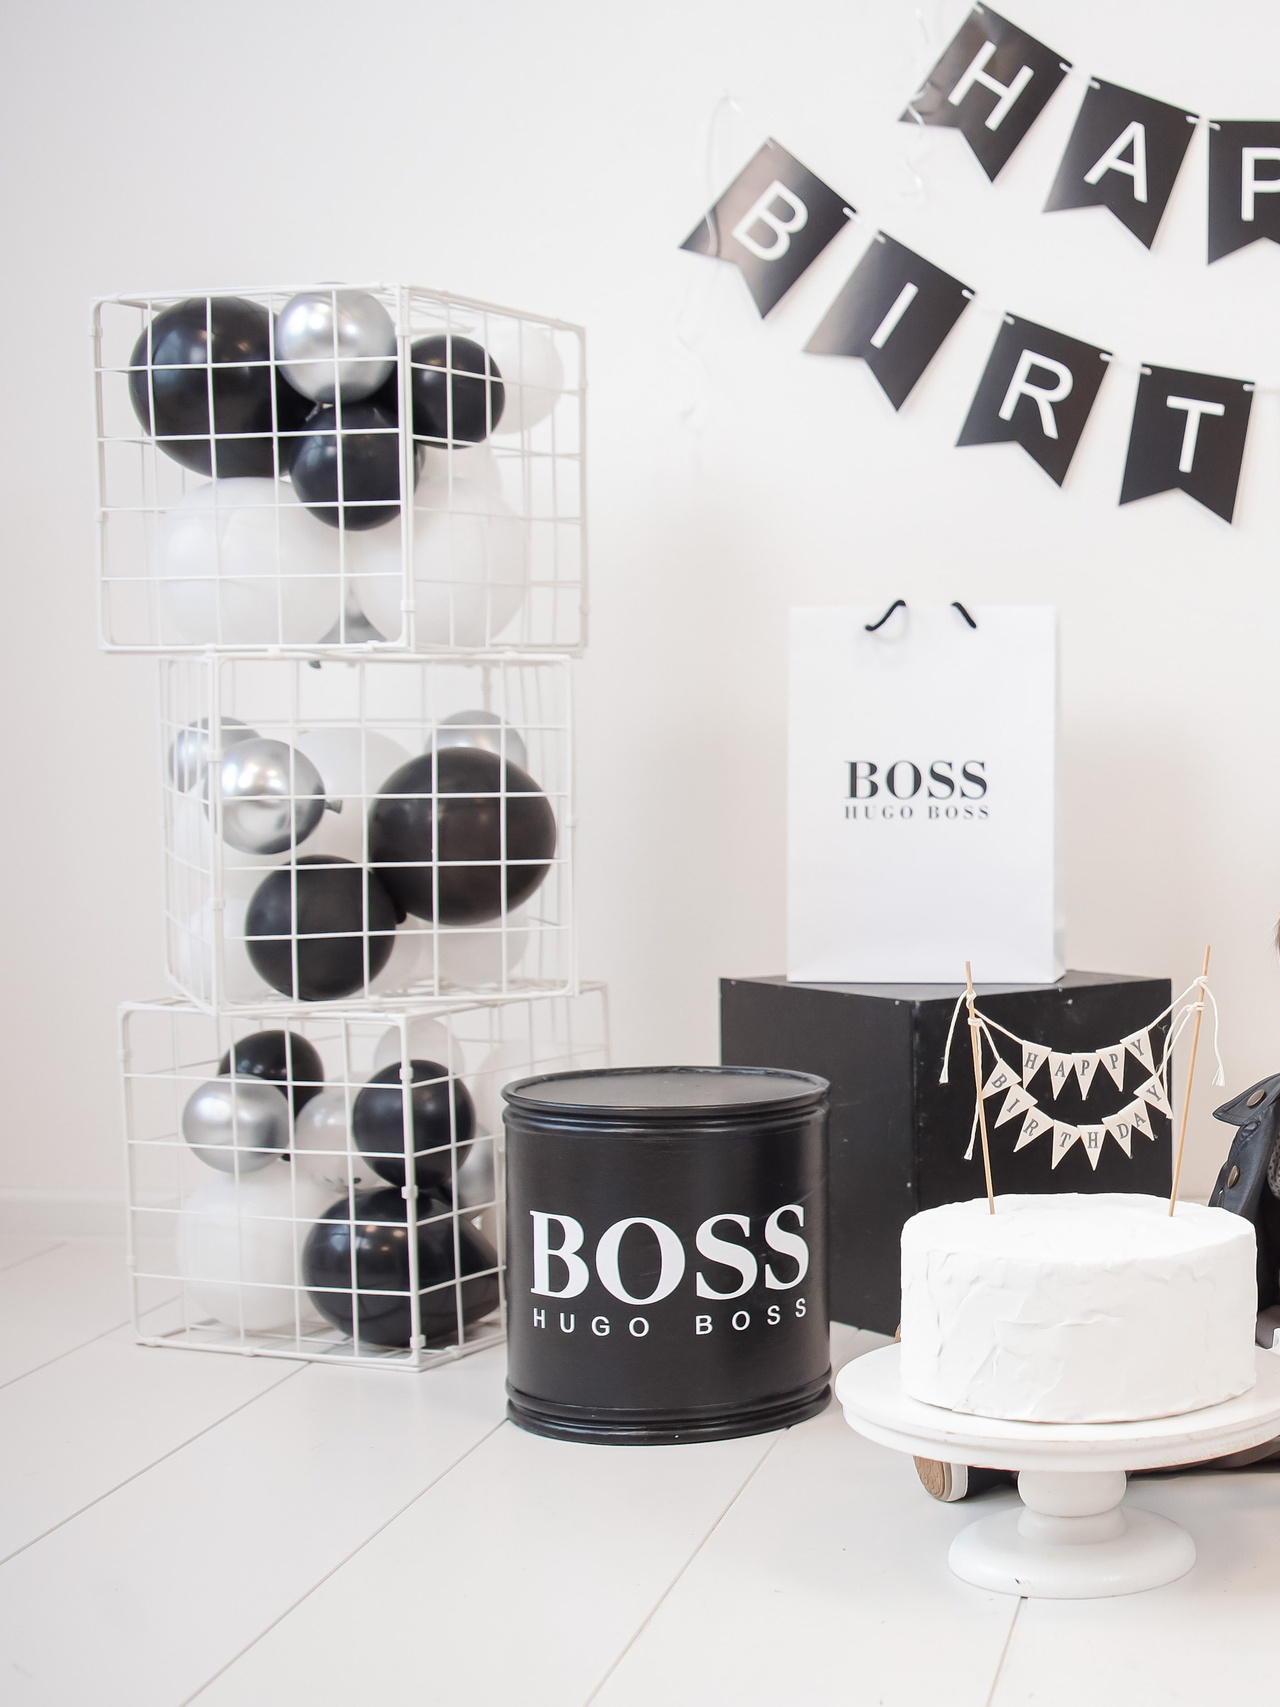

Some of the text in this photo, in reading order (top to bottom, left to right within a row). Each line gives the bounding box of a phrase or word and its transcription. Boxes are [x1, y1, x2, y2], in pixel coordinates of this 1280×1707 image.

[844, 760, 988, 800] BOSS
[844, 805, 990, 820] HUGO BOSS
[1023, 1038, 1145, 1078] HAPPY
[991, 1073, 1164, 1149] BIRTHDAY
[529, 1204, 810, 1306] BOSS
[533, 1297, 807, 1338] HUGO BOSS
